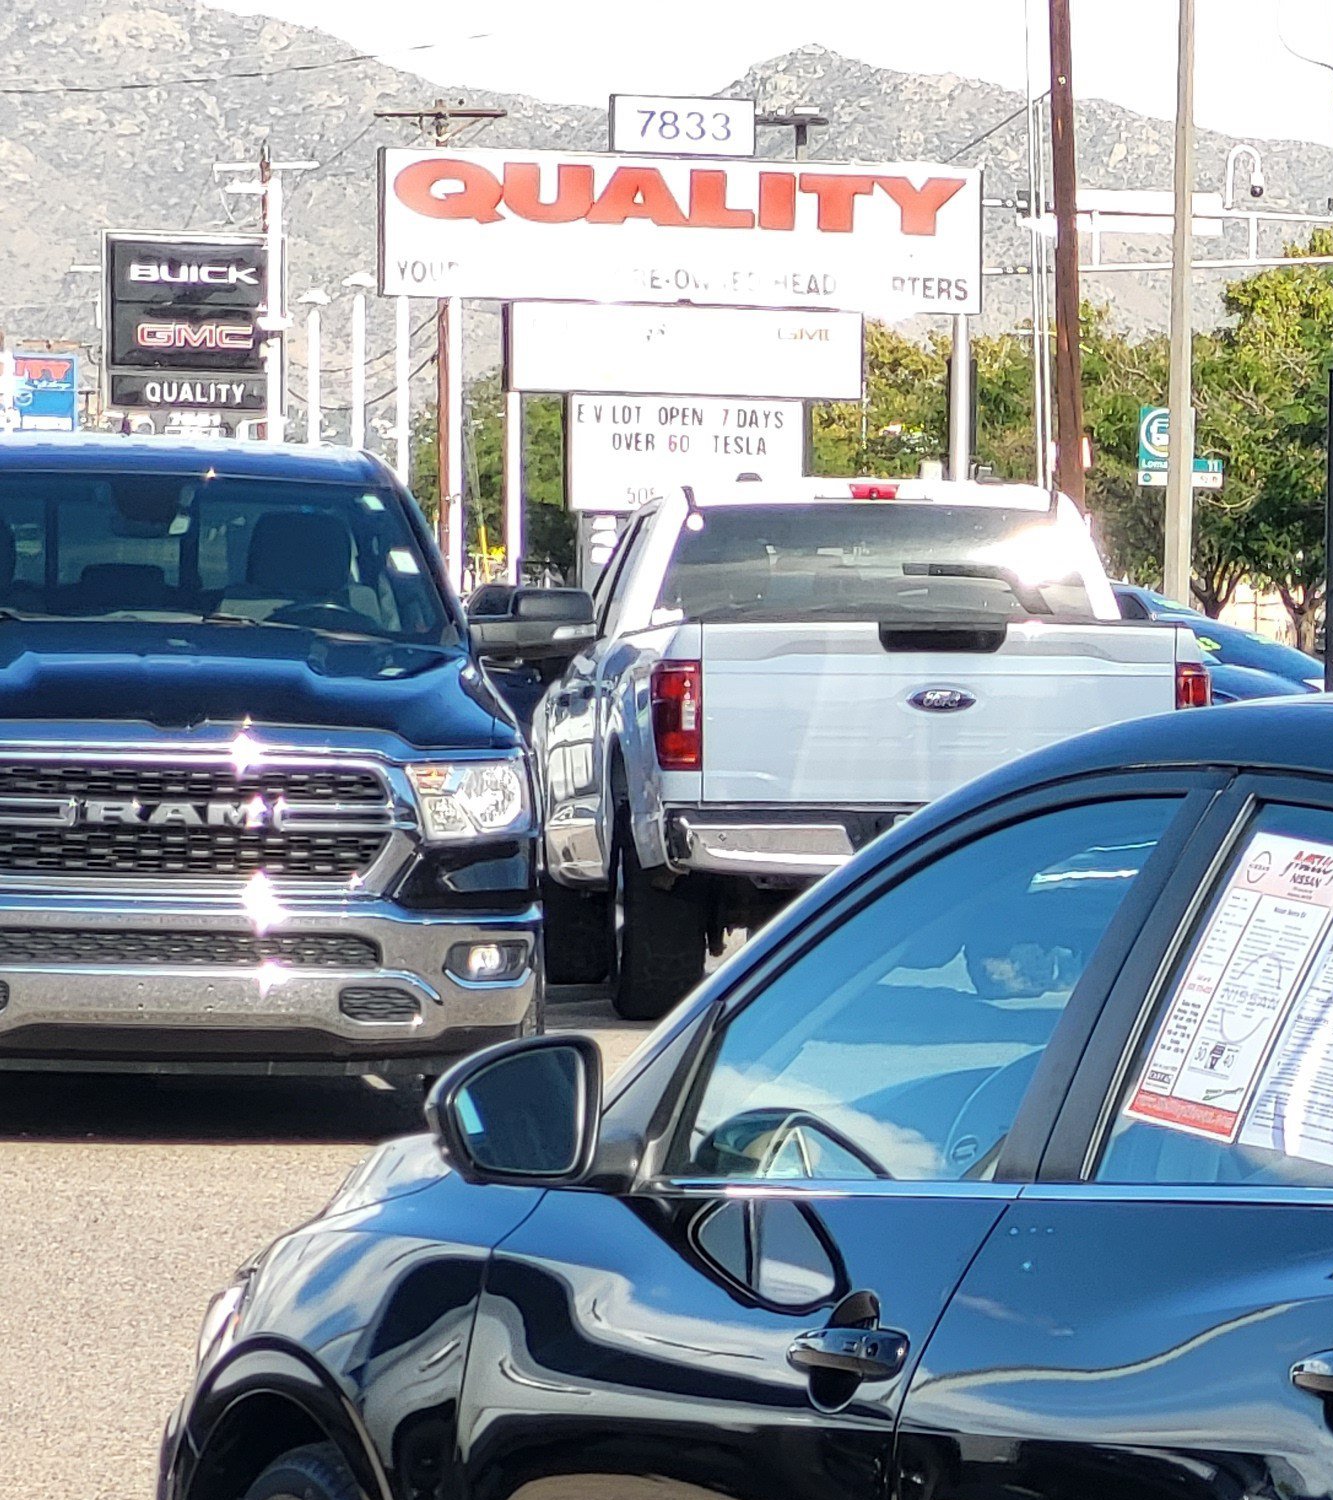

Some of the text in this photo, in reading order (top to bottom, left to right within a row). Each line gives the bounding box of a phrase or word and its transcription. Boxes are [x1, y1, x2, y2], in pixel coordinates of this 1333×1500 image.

[637, 110, 731, 142] 7833
[393, 158, 967, 237] QUALITY
[130, 262, 259, 285] BUICK
[137, 323, 254, 350] GMC
[145, 381, 246, 405] QUALITY
[612, 405, 642, 425] LOT
[658, 406, 703, 426] OPEN
[722, 408, 729, 427] 7
[737, 408, 784, 429] DAYS
[612, 432, 767, 456] OVER 60 TESLA
[86, 799, 266, 828] RAM
